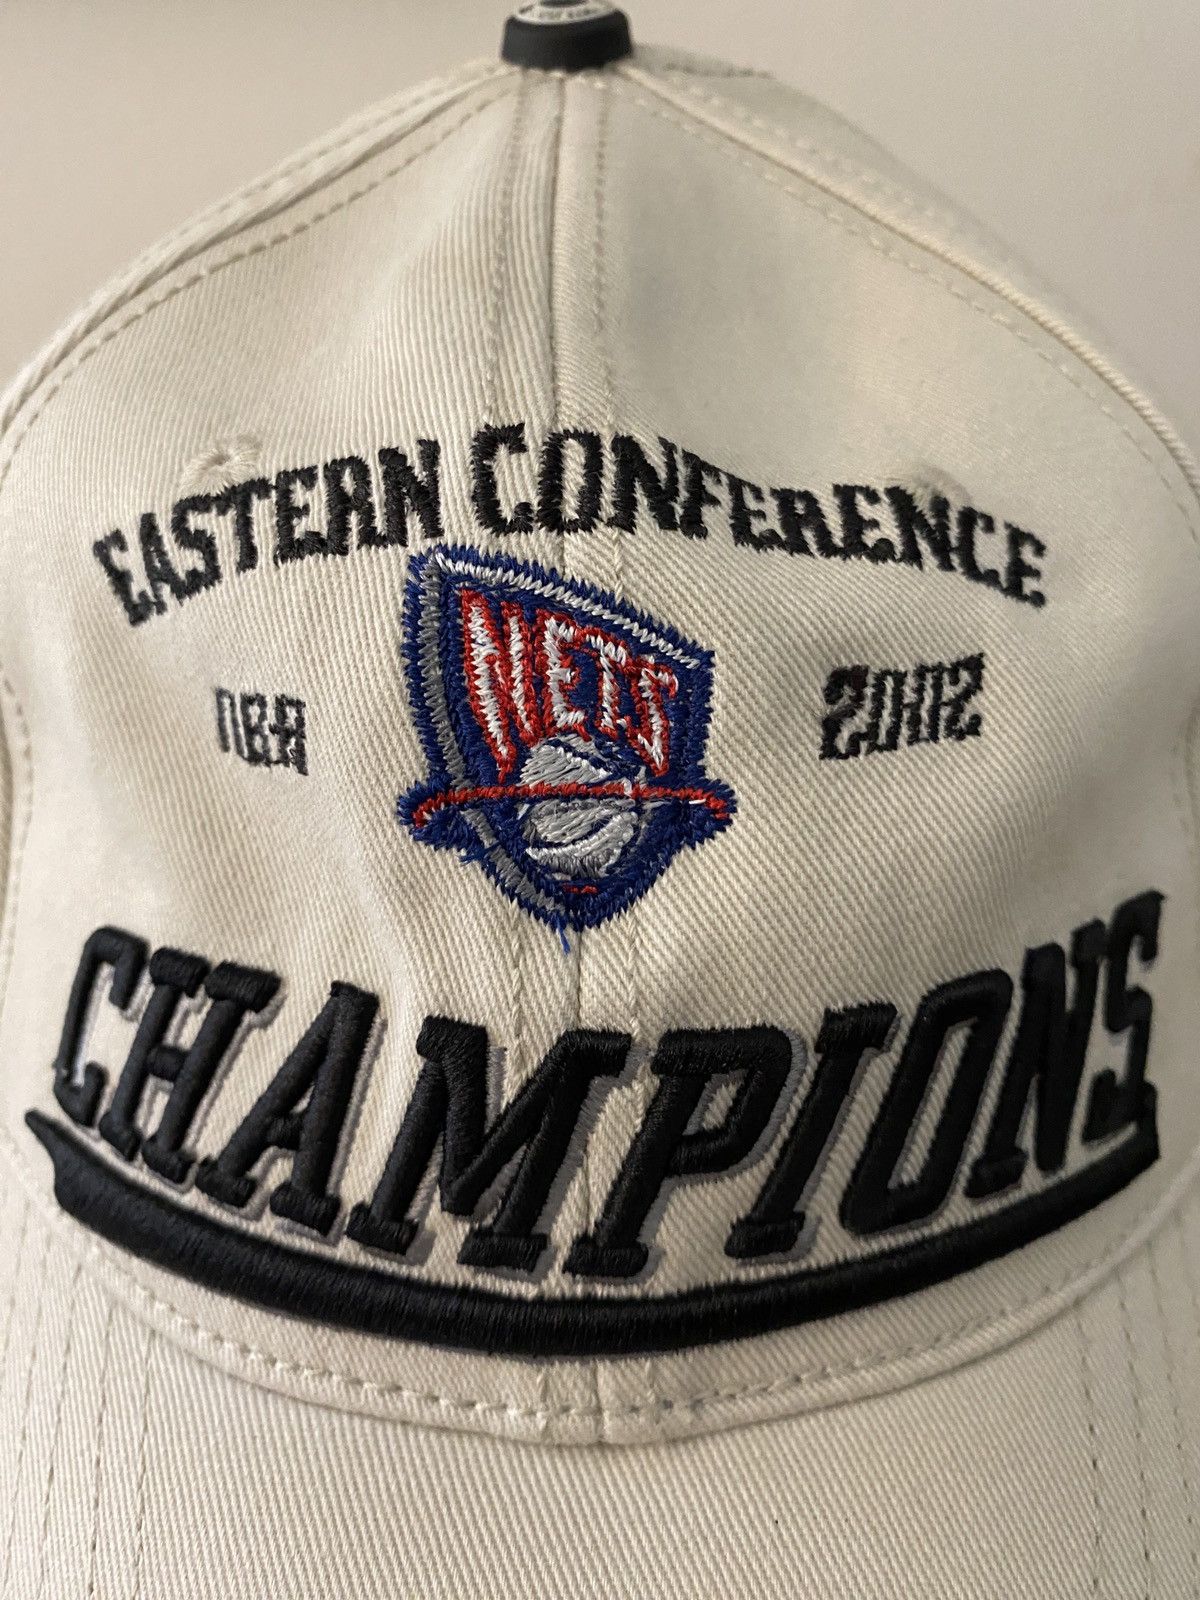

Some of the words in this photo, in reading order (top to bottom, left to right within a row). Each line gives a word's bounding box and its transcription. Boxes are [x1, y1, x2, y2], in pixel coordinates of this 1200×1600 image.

[93, 438, 444, 626] EASTERN
[470, 422, 1047, 608] CONFERENCE
[215, 687, 309, 776] NBA
[461, 586, 678, 783] NETS
[819, 652, 985, 760] 2002
[50, 889, 1166, 1281] CHAMPIONS
